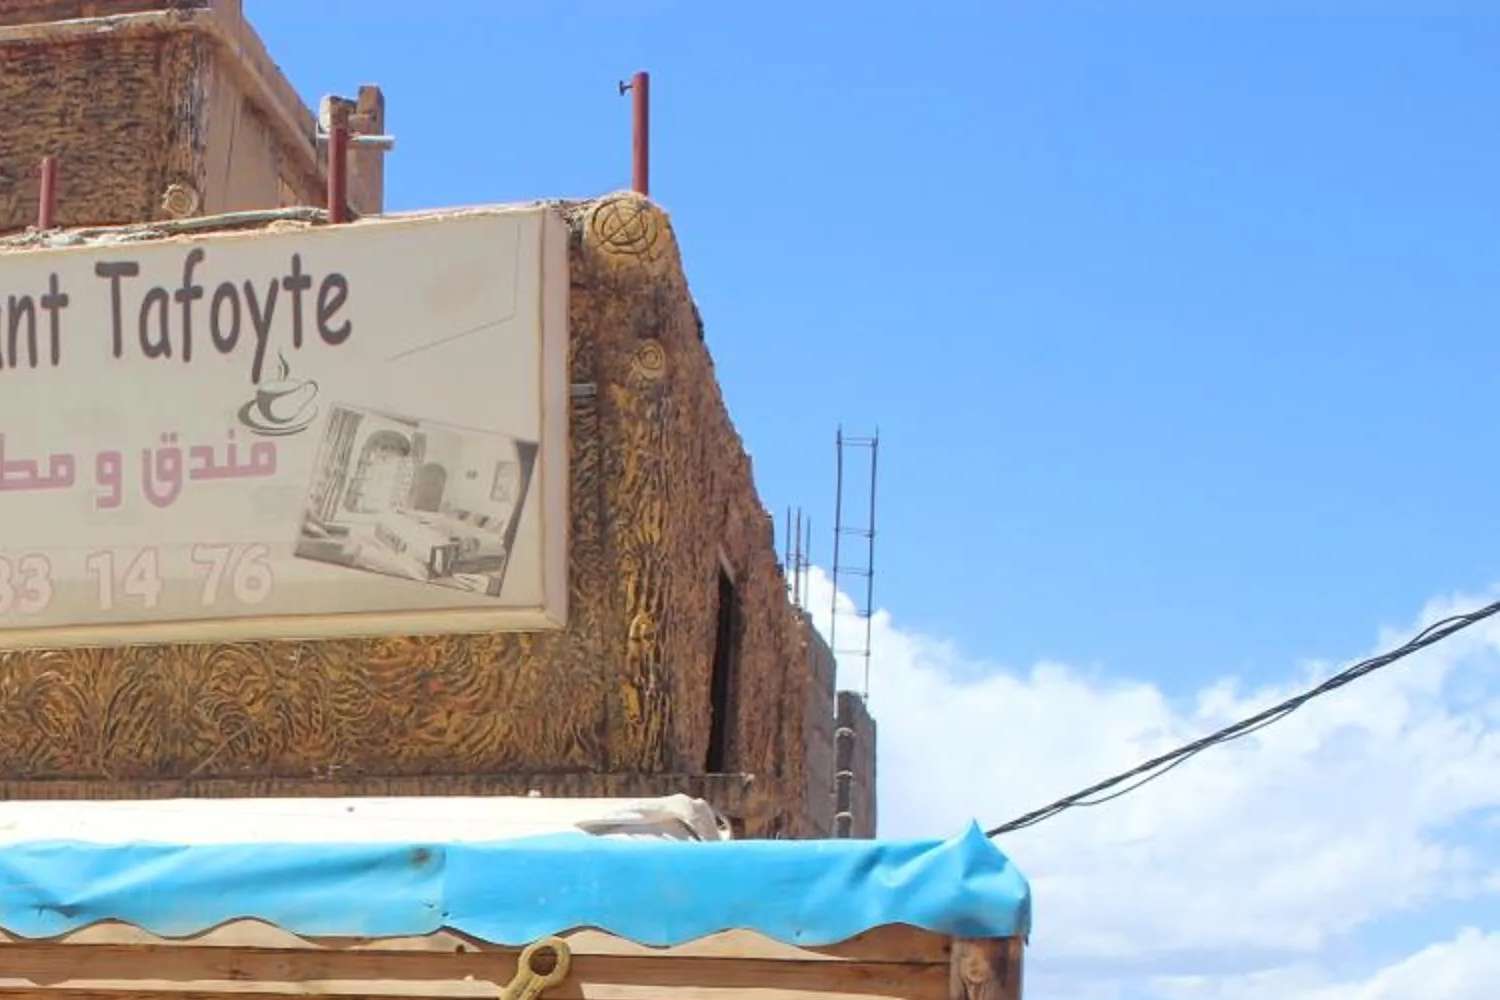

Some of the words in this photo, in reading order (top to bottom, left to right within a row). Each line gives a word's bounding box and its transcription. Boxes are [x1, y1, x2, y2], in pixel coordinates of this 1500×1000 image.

[95, 248, 352, 384] Tafoyte
[96, 451, 122, 510] و
[86, 545, 164, 610] 14
[190, 541, 275, 605] 76
